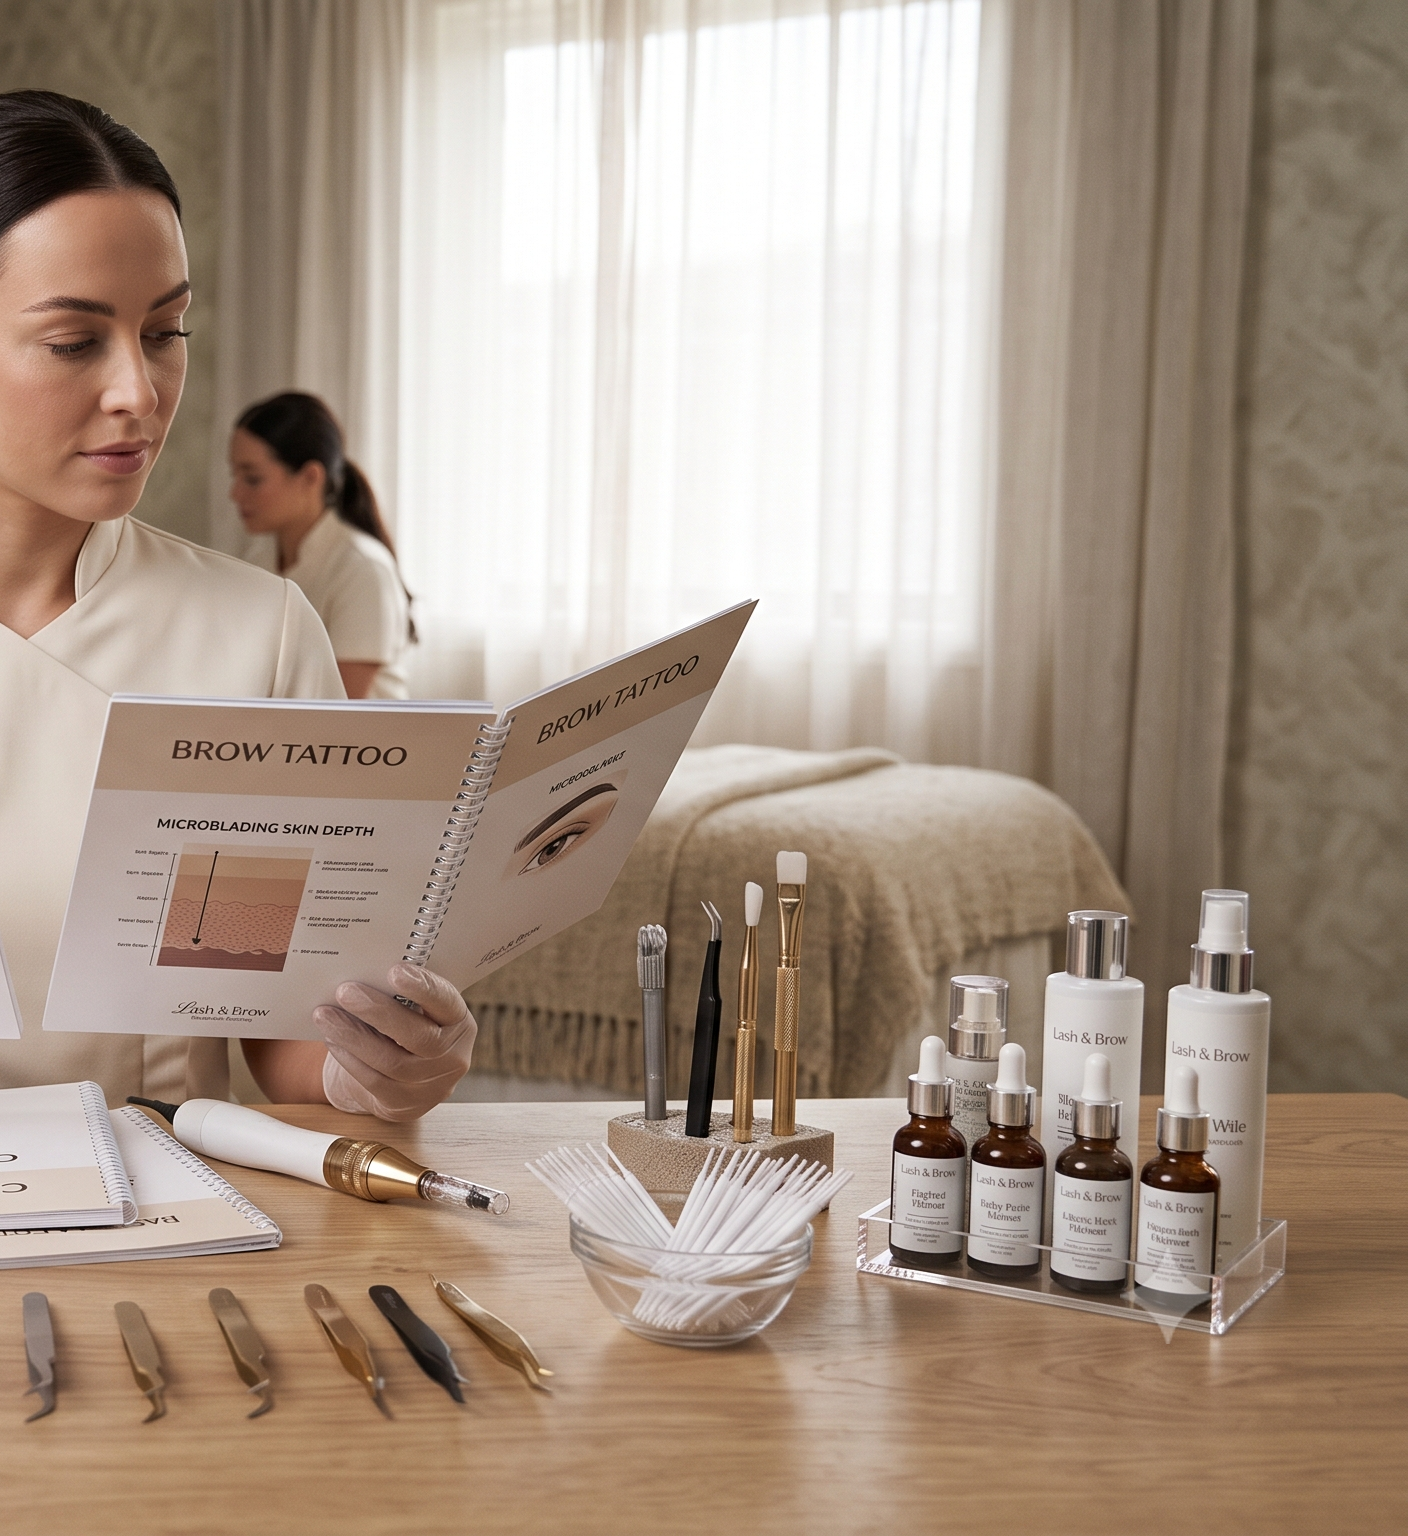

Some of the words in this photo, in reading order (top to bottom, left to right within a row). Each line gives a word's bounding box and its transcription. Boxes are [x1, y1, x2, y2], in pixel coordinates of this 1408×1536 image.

[536, 695, 611, 745] BROW
[613, 655, 700, 709] TATTOO
[171, 739, 275, 763] BROW
[281, 744, 408, 767] TATTOO
[156, 818, 279, 833] MICROBLADING
[282, 822, 319, 835] SKIN
[322, 824, 375, 837] DEPTH
[171, 1001, 214, 1015] Lash
[218, 1006, 229, 1015] &
[232, 1006, 271, 1017] Brow
[1053, 1027, 1078, 1043] Lash
[1081, 1032, 1092, 1045] &
[1095, 1033, 1129, 1046] Brow
[1172, 1041, 1196, 1058] Lash
[1199, 1047, 1211, 1061] &
[1214, 1048, 1251, 1063] Brow
[922, 1168, 931, 1178] &
[932, 1168, 957, 1178] Brow
[997, 1178, 1008, 1188] &
[1008, 1179, 1035, 1189] Brow
[1060, 1186, 1081, 1201] Lash
[1082, 1191, 1093, 1202] &
[1164, 1202, 1174, 1212] &
[1175, 1202, 1204, 1214] Brow
